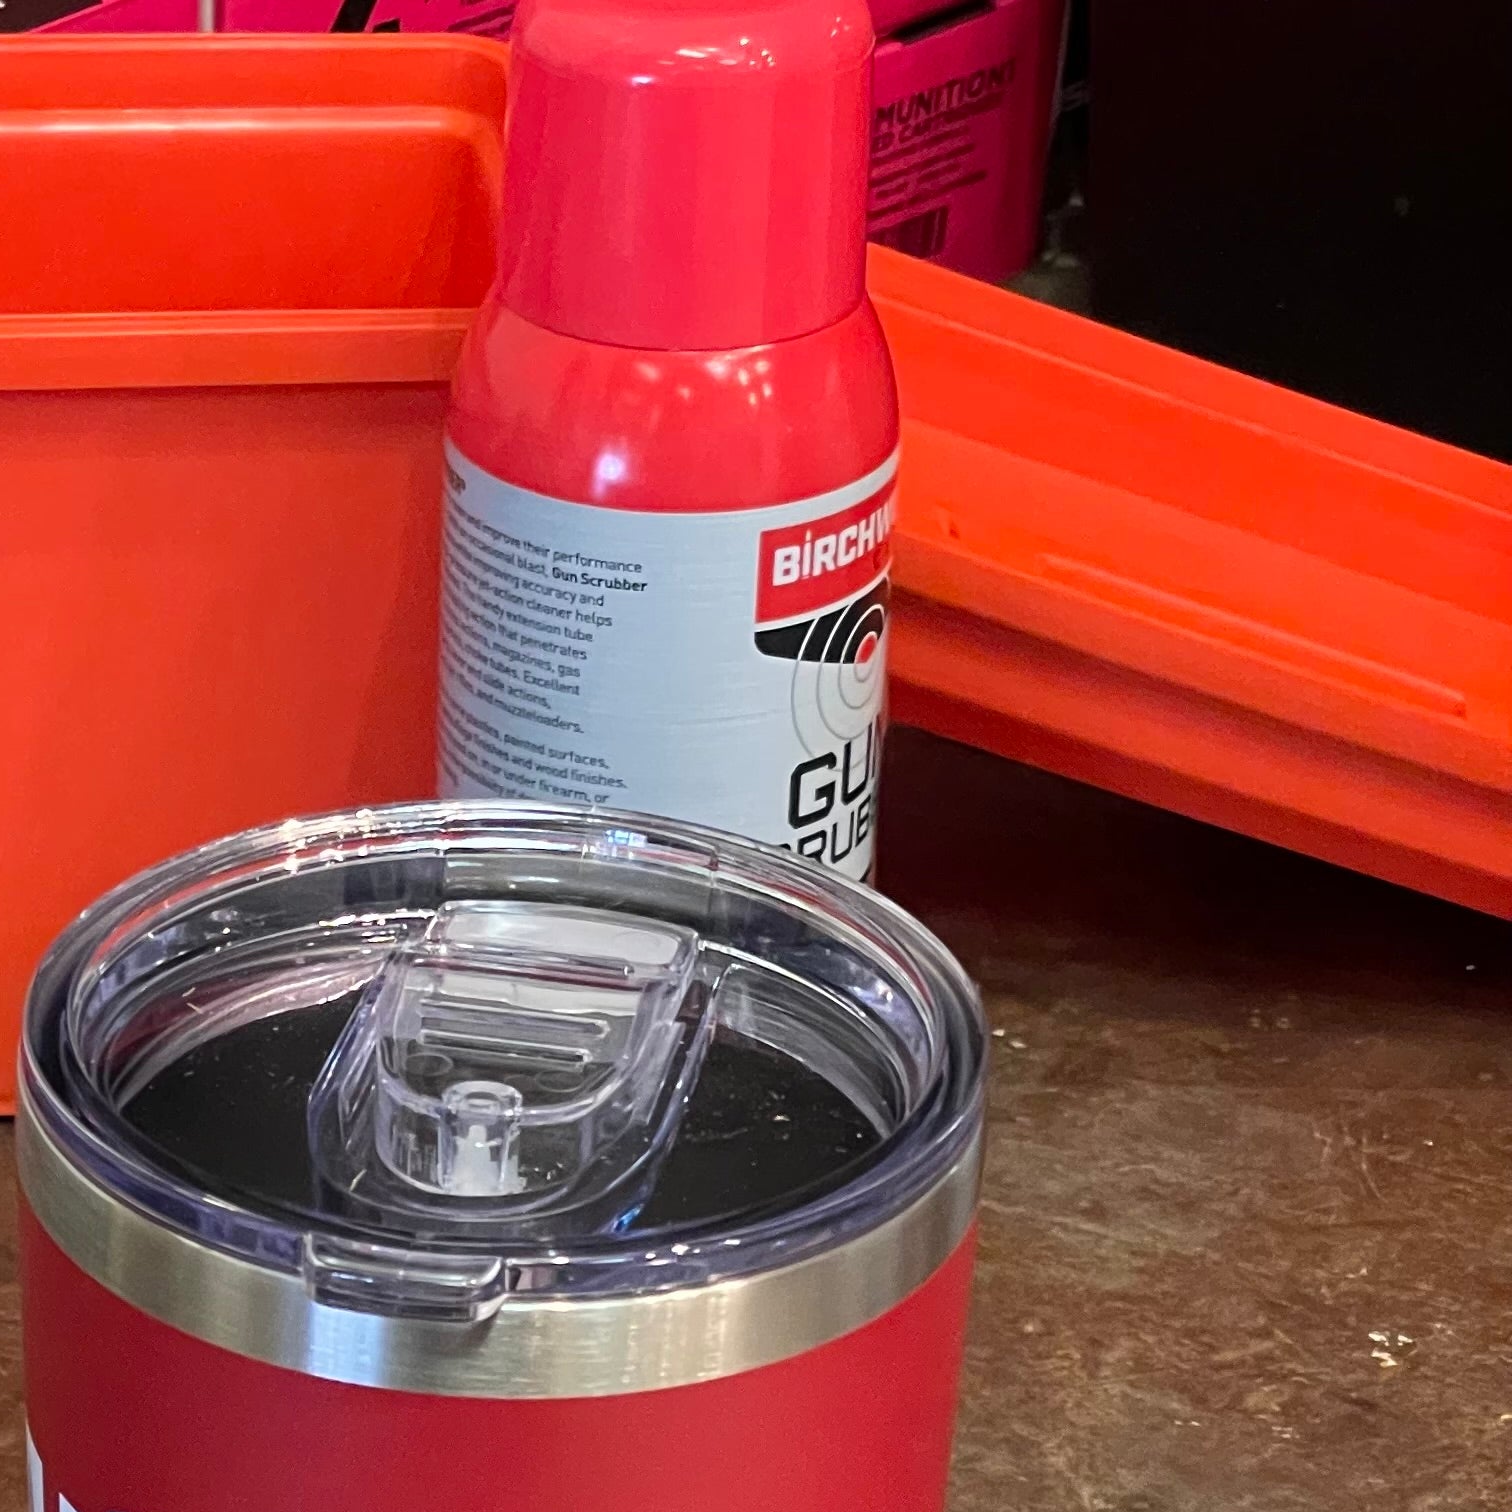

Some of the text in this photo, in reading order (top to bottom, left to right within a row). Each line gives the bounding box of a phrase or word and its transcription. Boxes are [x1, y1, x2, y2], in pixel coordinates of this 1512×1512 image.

[553, 550, 642, 574] performance
[552, 567, 578, 583] Gun
[581, 573, 648, 592] Scrubber
[522, 578, 577, 605] accuracy
[579, 594, 604, 607] and
[526, 598, 572, 621] cleaner
[574, 609, 613, 628] helps
[564, 625, 594, 643] tube
[520, 634, 588, 661] penetrates
[523, 670, 580, 696] Excellent
[557, 664, 581, 679] gas
[536, 763, 568, 779] wood
[594, 793, 610, 804] or
